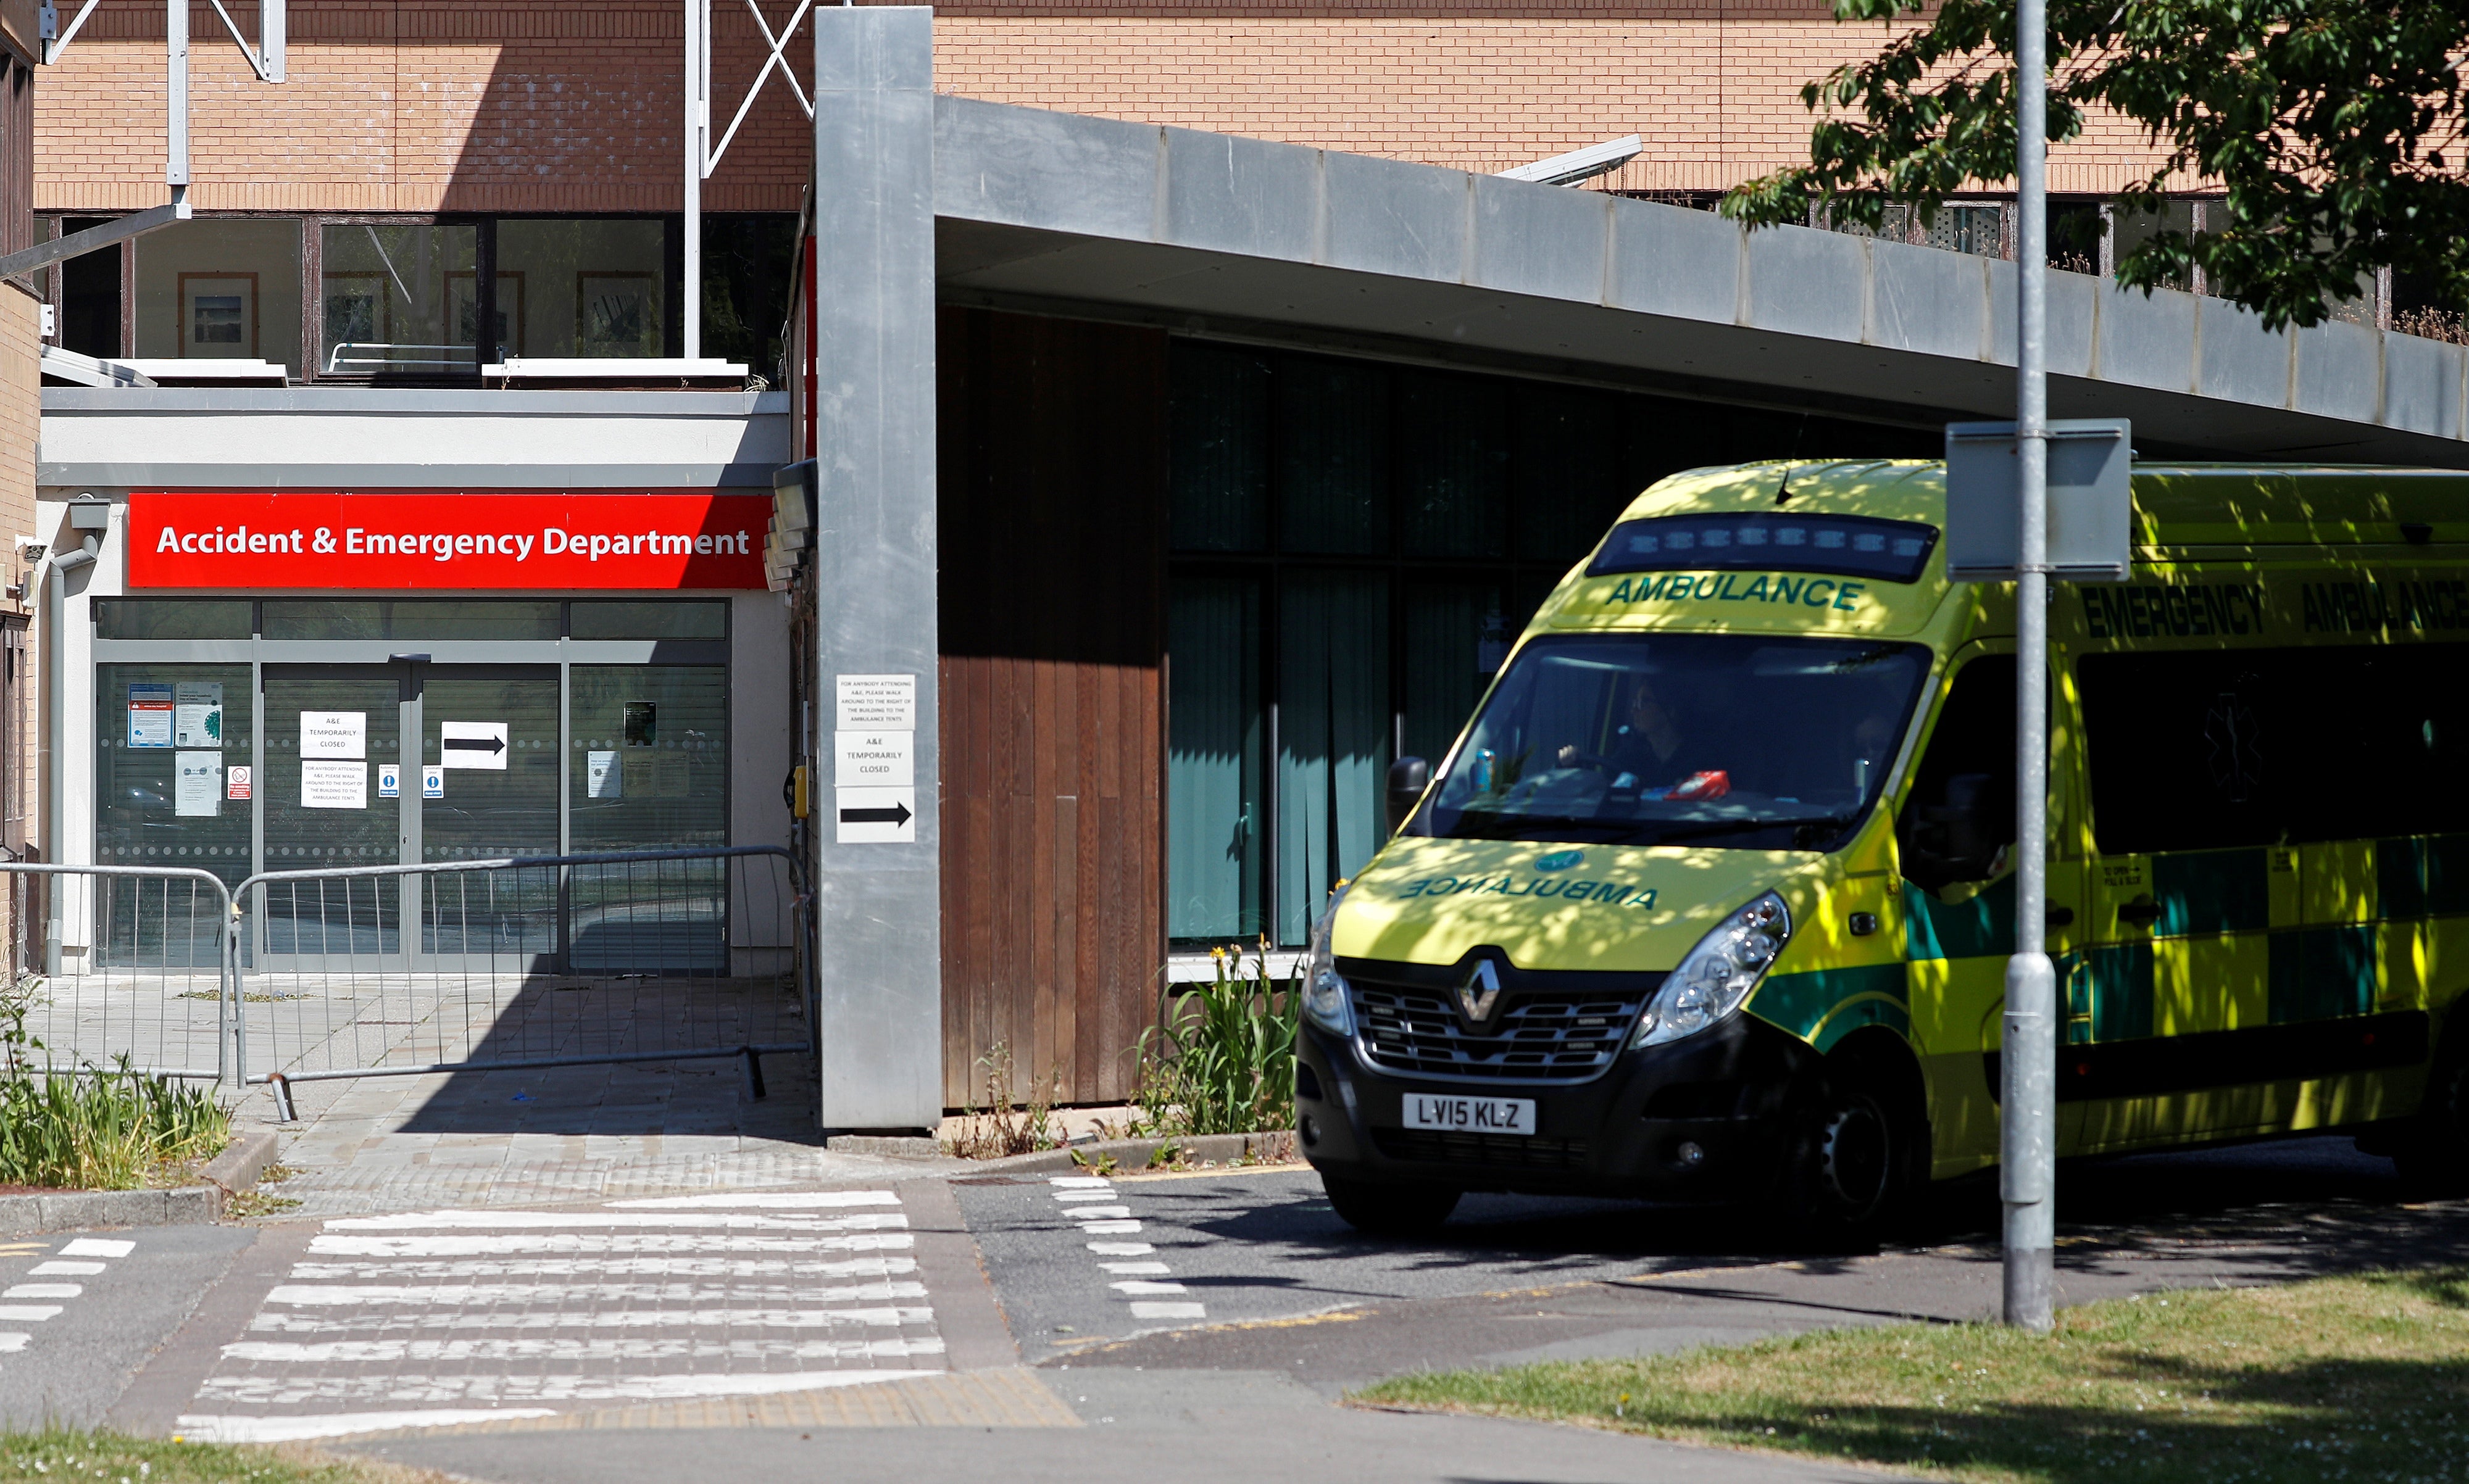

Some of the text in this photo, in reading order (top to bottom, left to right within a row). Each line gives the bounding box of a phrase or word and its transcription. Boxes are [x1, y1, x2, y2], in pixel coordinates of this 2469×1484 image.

[156, 526, 749, 562] Accident & Emergency Department
[1605, 575, 1865, 611] AMBULANCE
[2081, 581, 2469, 638] EMERGENCY AMBULANCE
[1419, 1099, 1519, 1128] LV15 KLZ
